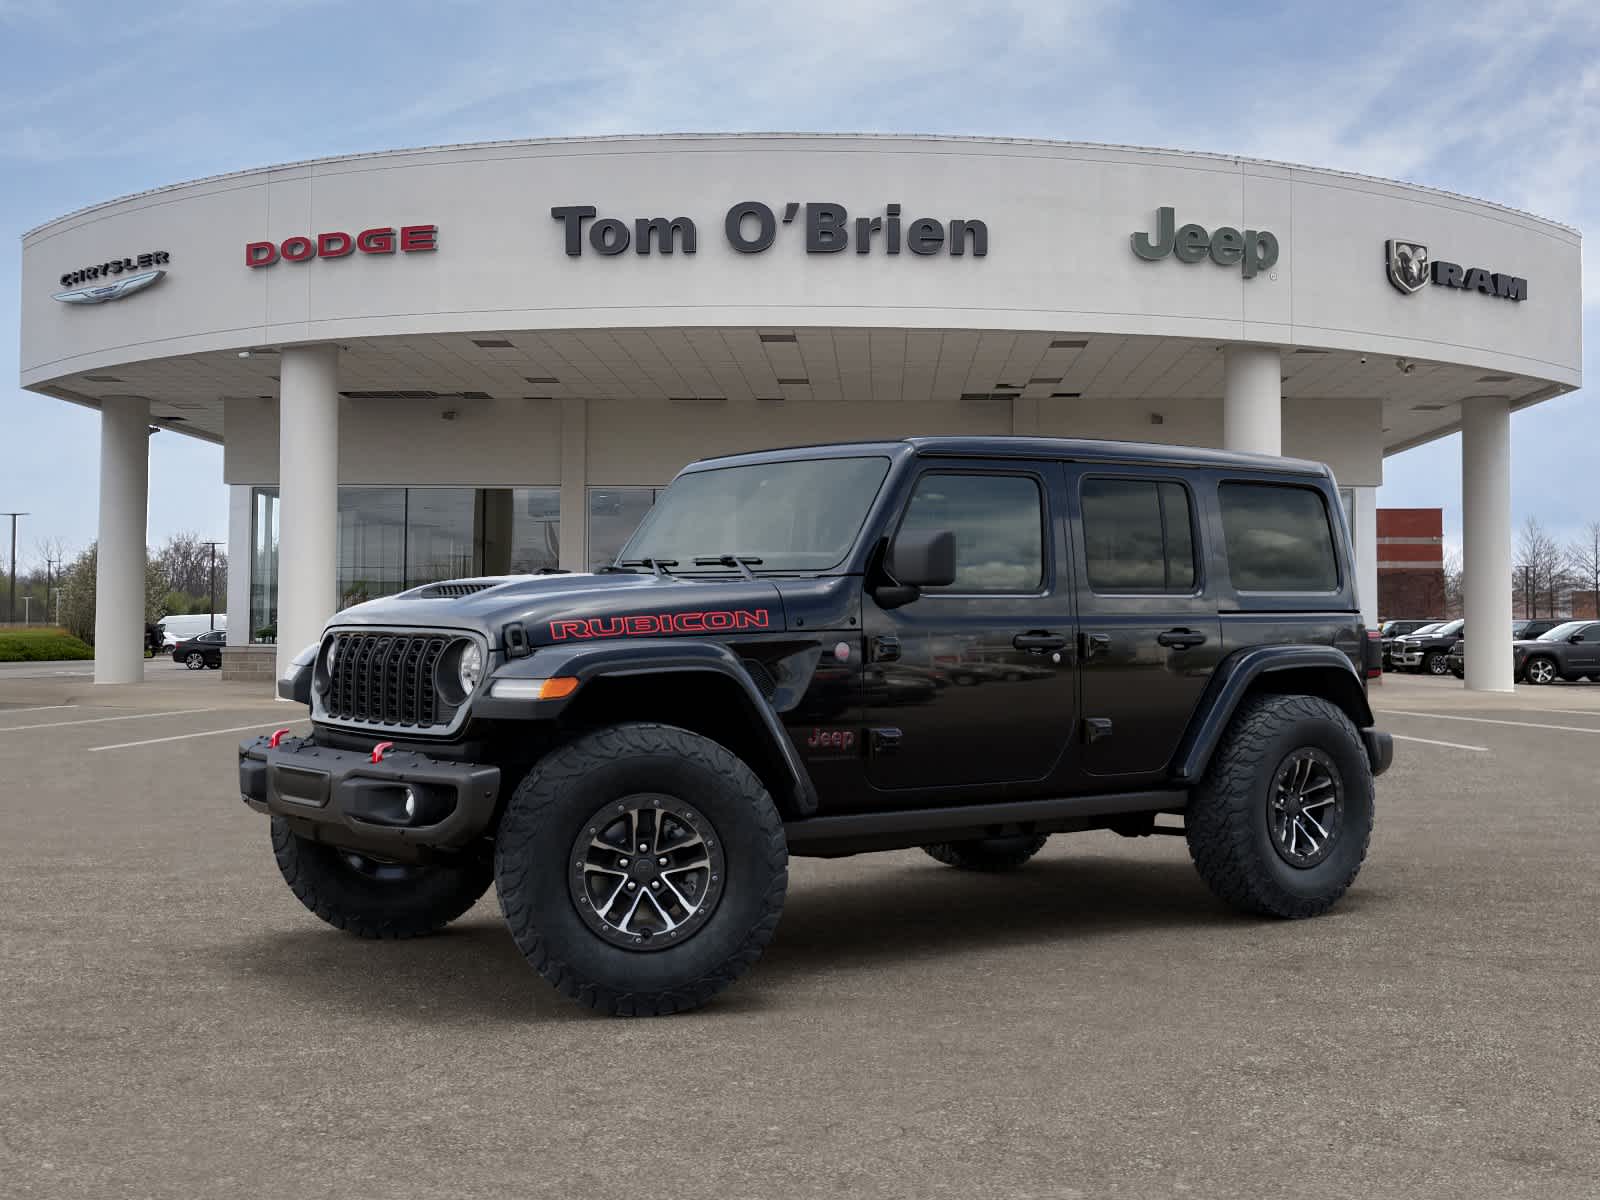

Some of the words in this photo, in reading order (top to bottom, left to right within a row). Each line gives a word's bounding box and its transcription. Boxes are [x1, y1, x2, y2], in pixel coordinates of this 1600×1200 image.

[245, 224, 438, 269] DODGE
[551, 205, 697, 257] Tom
[724, 200, 989, 257] O'Brien
[1130, 206, 1280, 279] Jeep
[60, 249, 170, 287] CHRYSLER
[1431, 260, 1528, 302] RAM
[550, 608, 769, 641] RUBICON
[808, 726, 855, 750] Jeep
